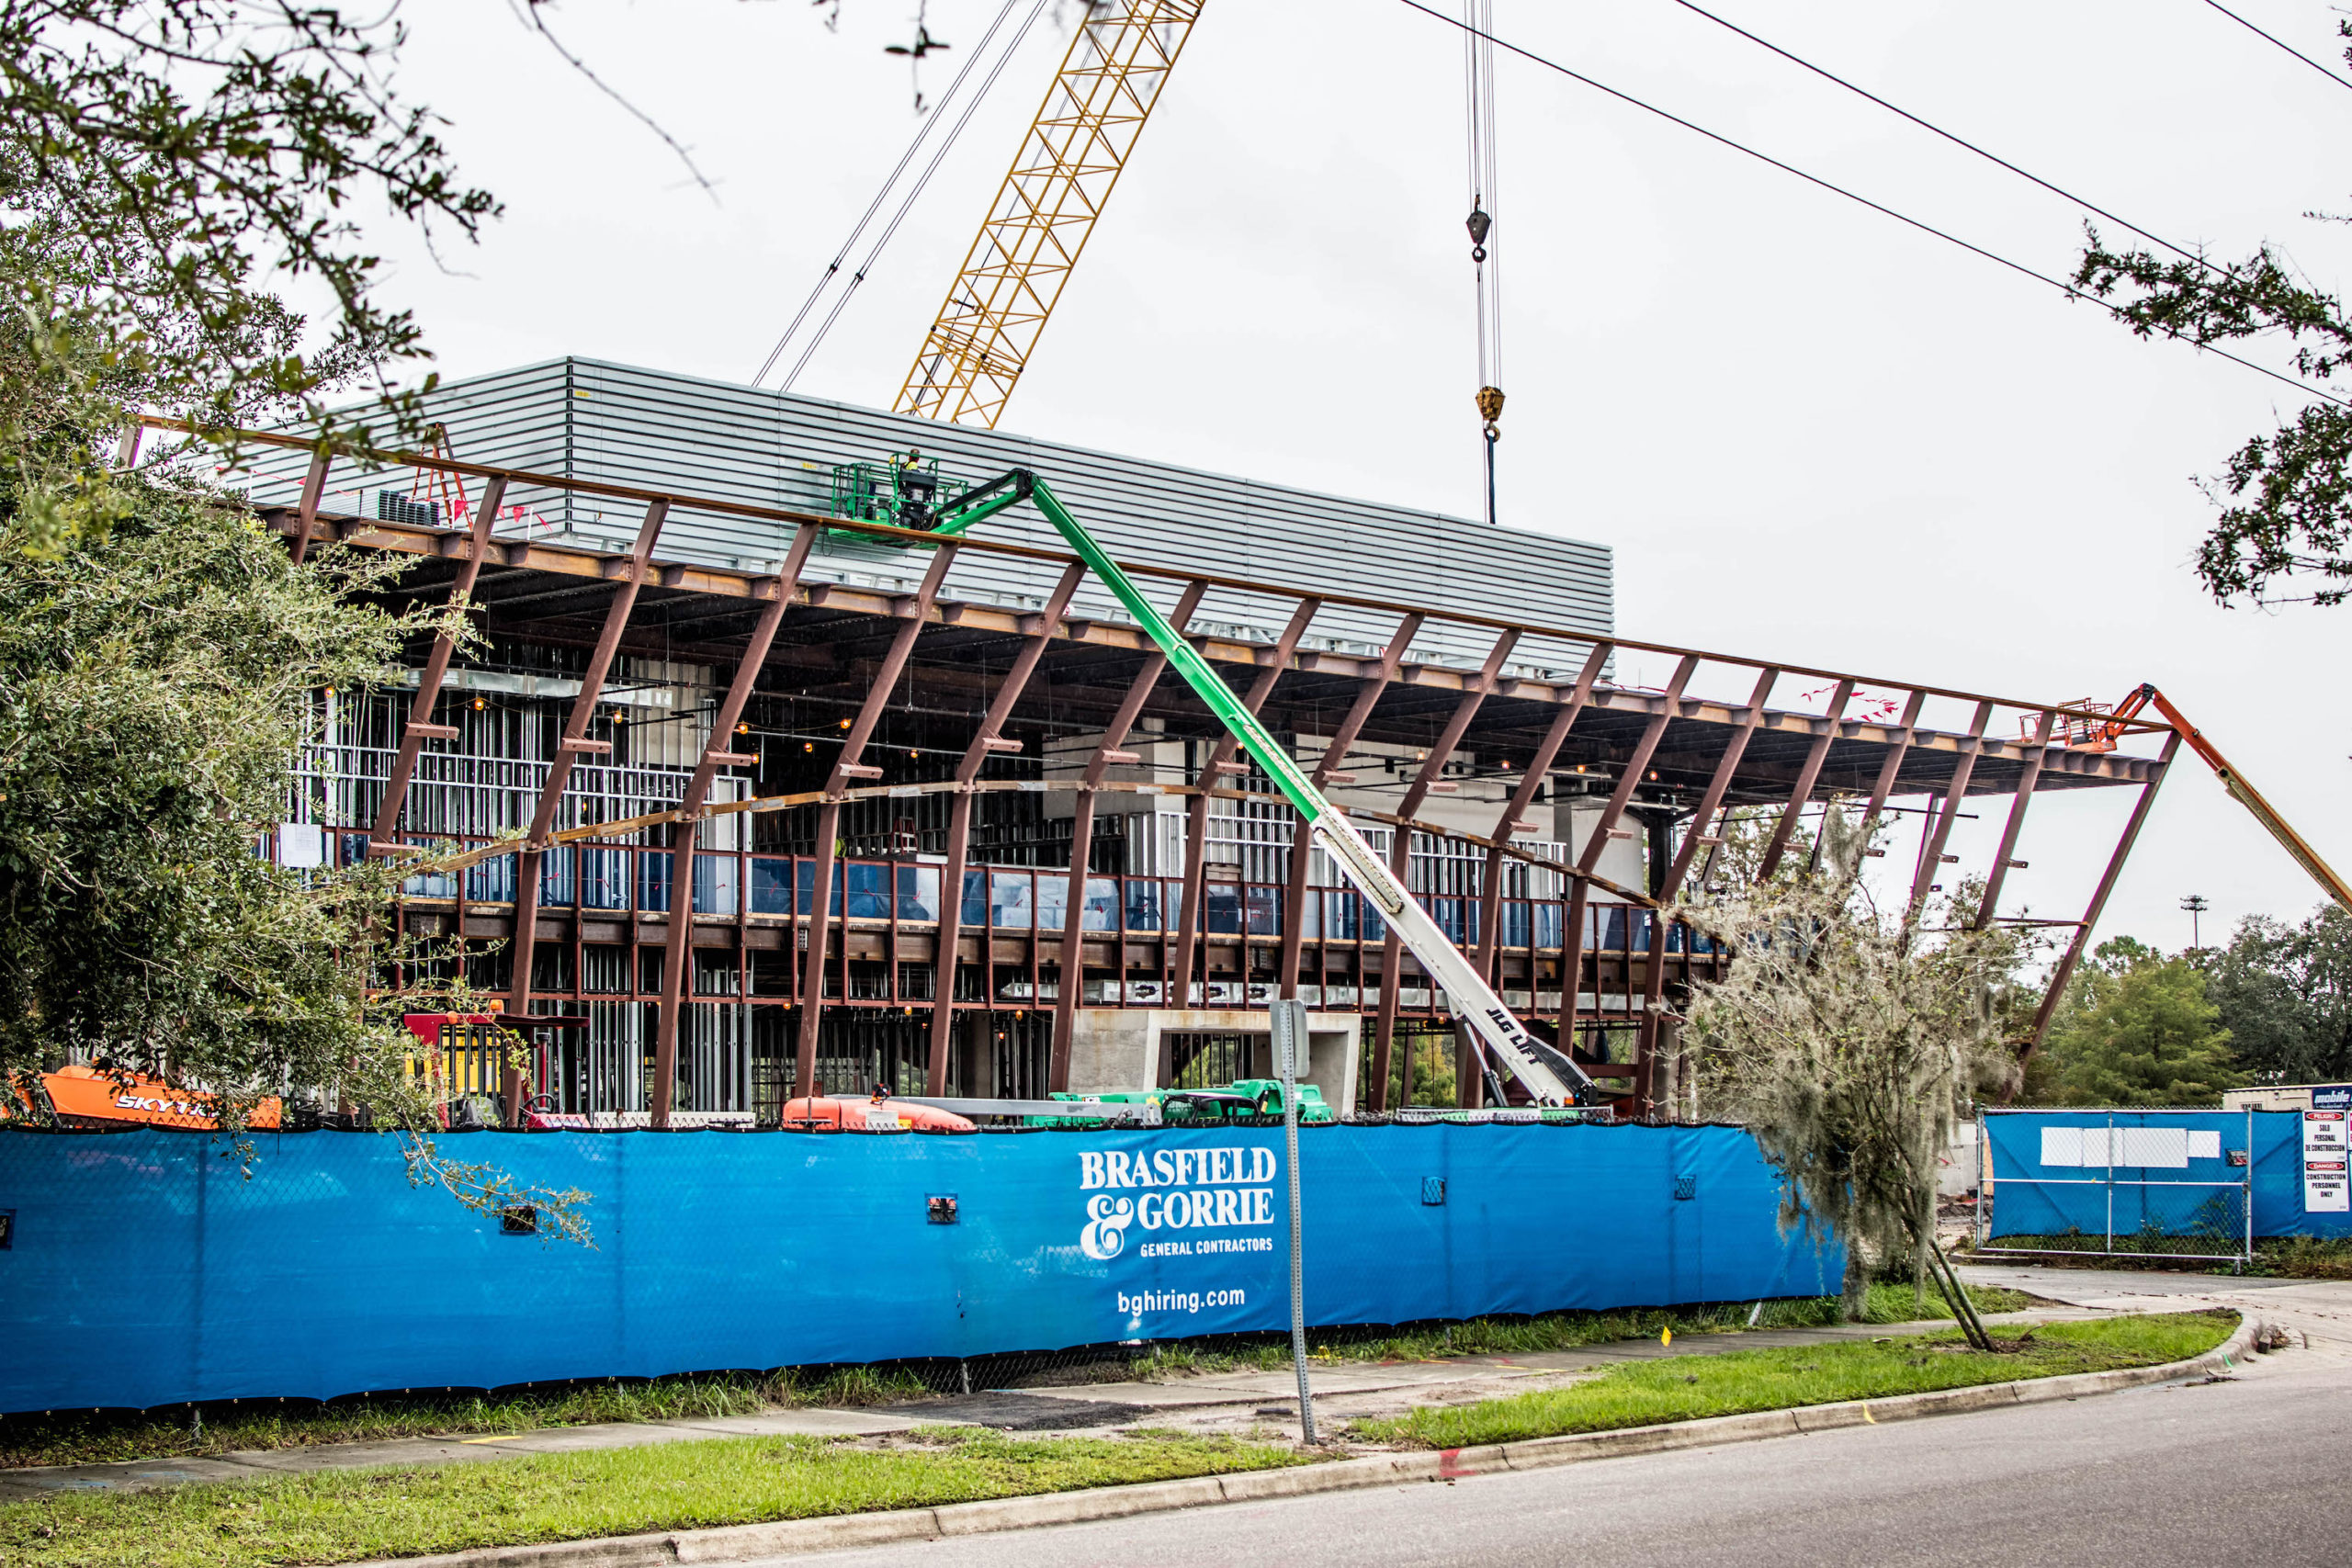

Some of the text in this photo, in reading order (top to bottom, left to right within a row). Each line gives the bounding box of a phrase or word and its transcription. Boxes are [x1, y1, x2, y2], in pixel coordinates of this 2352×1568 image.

[1485, 1009, 1544, 1065] JLG LIFT
[2314, 1089, 2350, 1103] mobile
[1079, 1147, 1276, 1190] BRASFIELD
[1080, 1189, 1274, 1259] & GORRIE
[1140, 1237, 1272, 1257] GENERAL CONTRACTORS
[1118, 1288, 1245, 1316] bghiring.com
